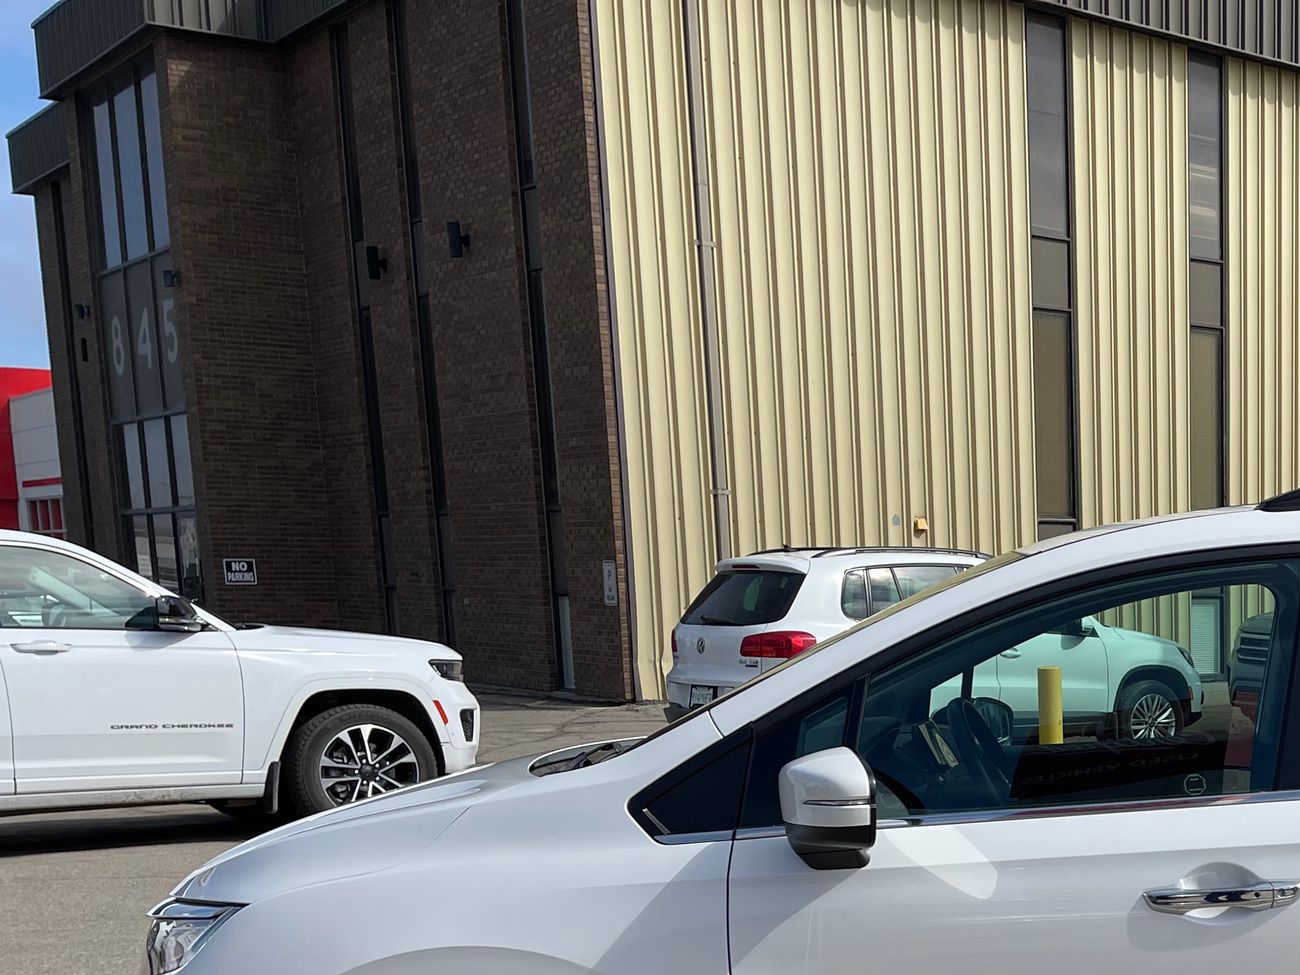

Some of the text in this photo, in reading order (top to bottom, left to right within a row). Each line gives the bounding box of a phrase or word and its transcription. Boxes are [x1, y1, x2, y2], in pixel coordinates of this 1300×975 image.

[111, 298, 178, 376] 845
[231, 561, 248, 572] NO
[227, 571, 254, 582] PARKING
